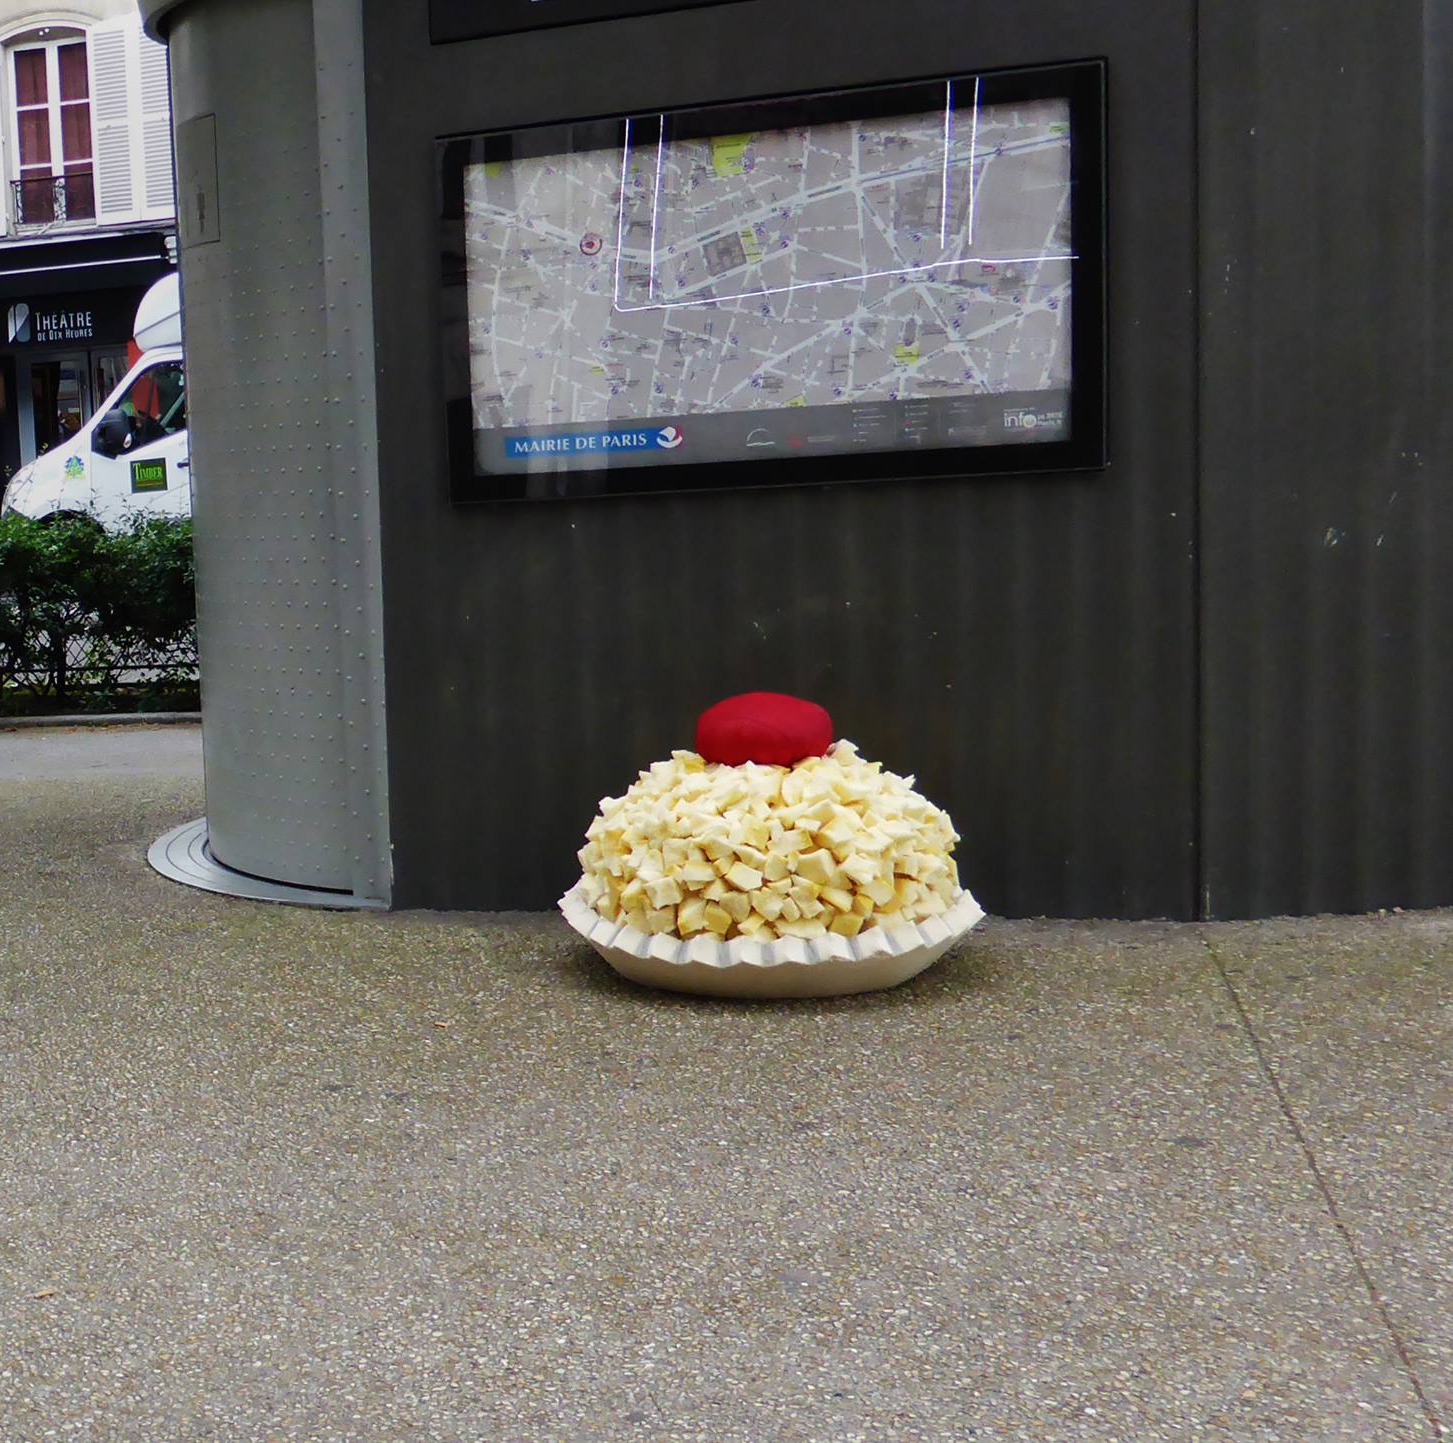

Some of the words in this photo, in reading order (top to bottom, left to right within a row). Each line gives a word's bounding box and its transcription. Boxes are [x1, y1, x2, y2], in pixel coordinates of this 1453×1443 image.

[37, 333, 46, 342] DE
[49, 330, 63, 340] DIX
[65, 328, 93, 338] HEURES
[514, 439, 570, 453] MAIRIE
[575, 436, 597, 449] DE
[602, 433, 647, 447] PARIS
[133, 463, 163, 480] TIMBER
